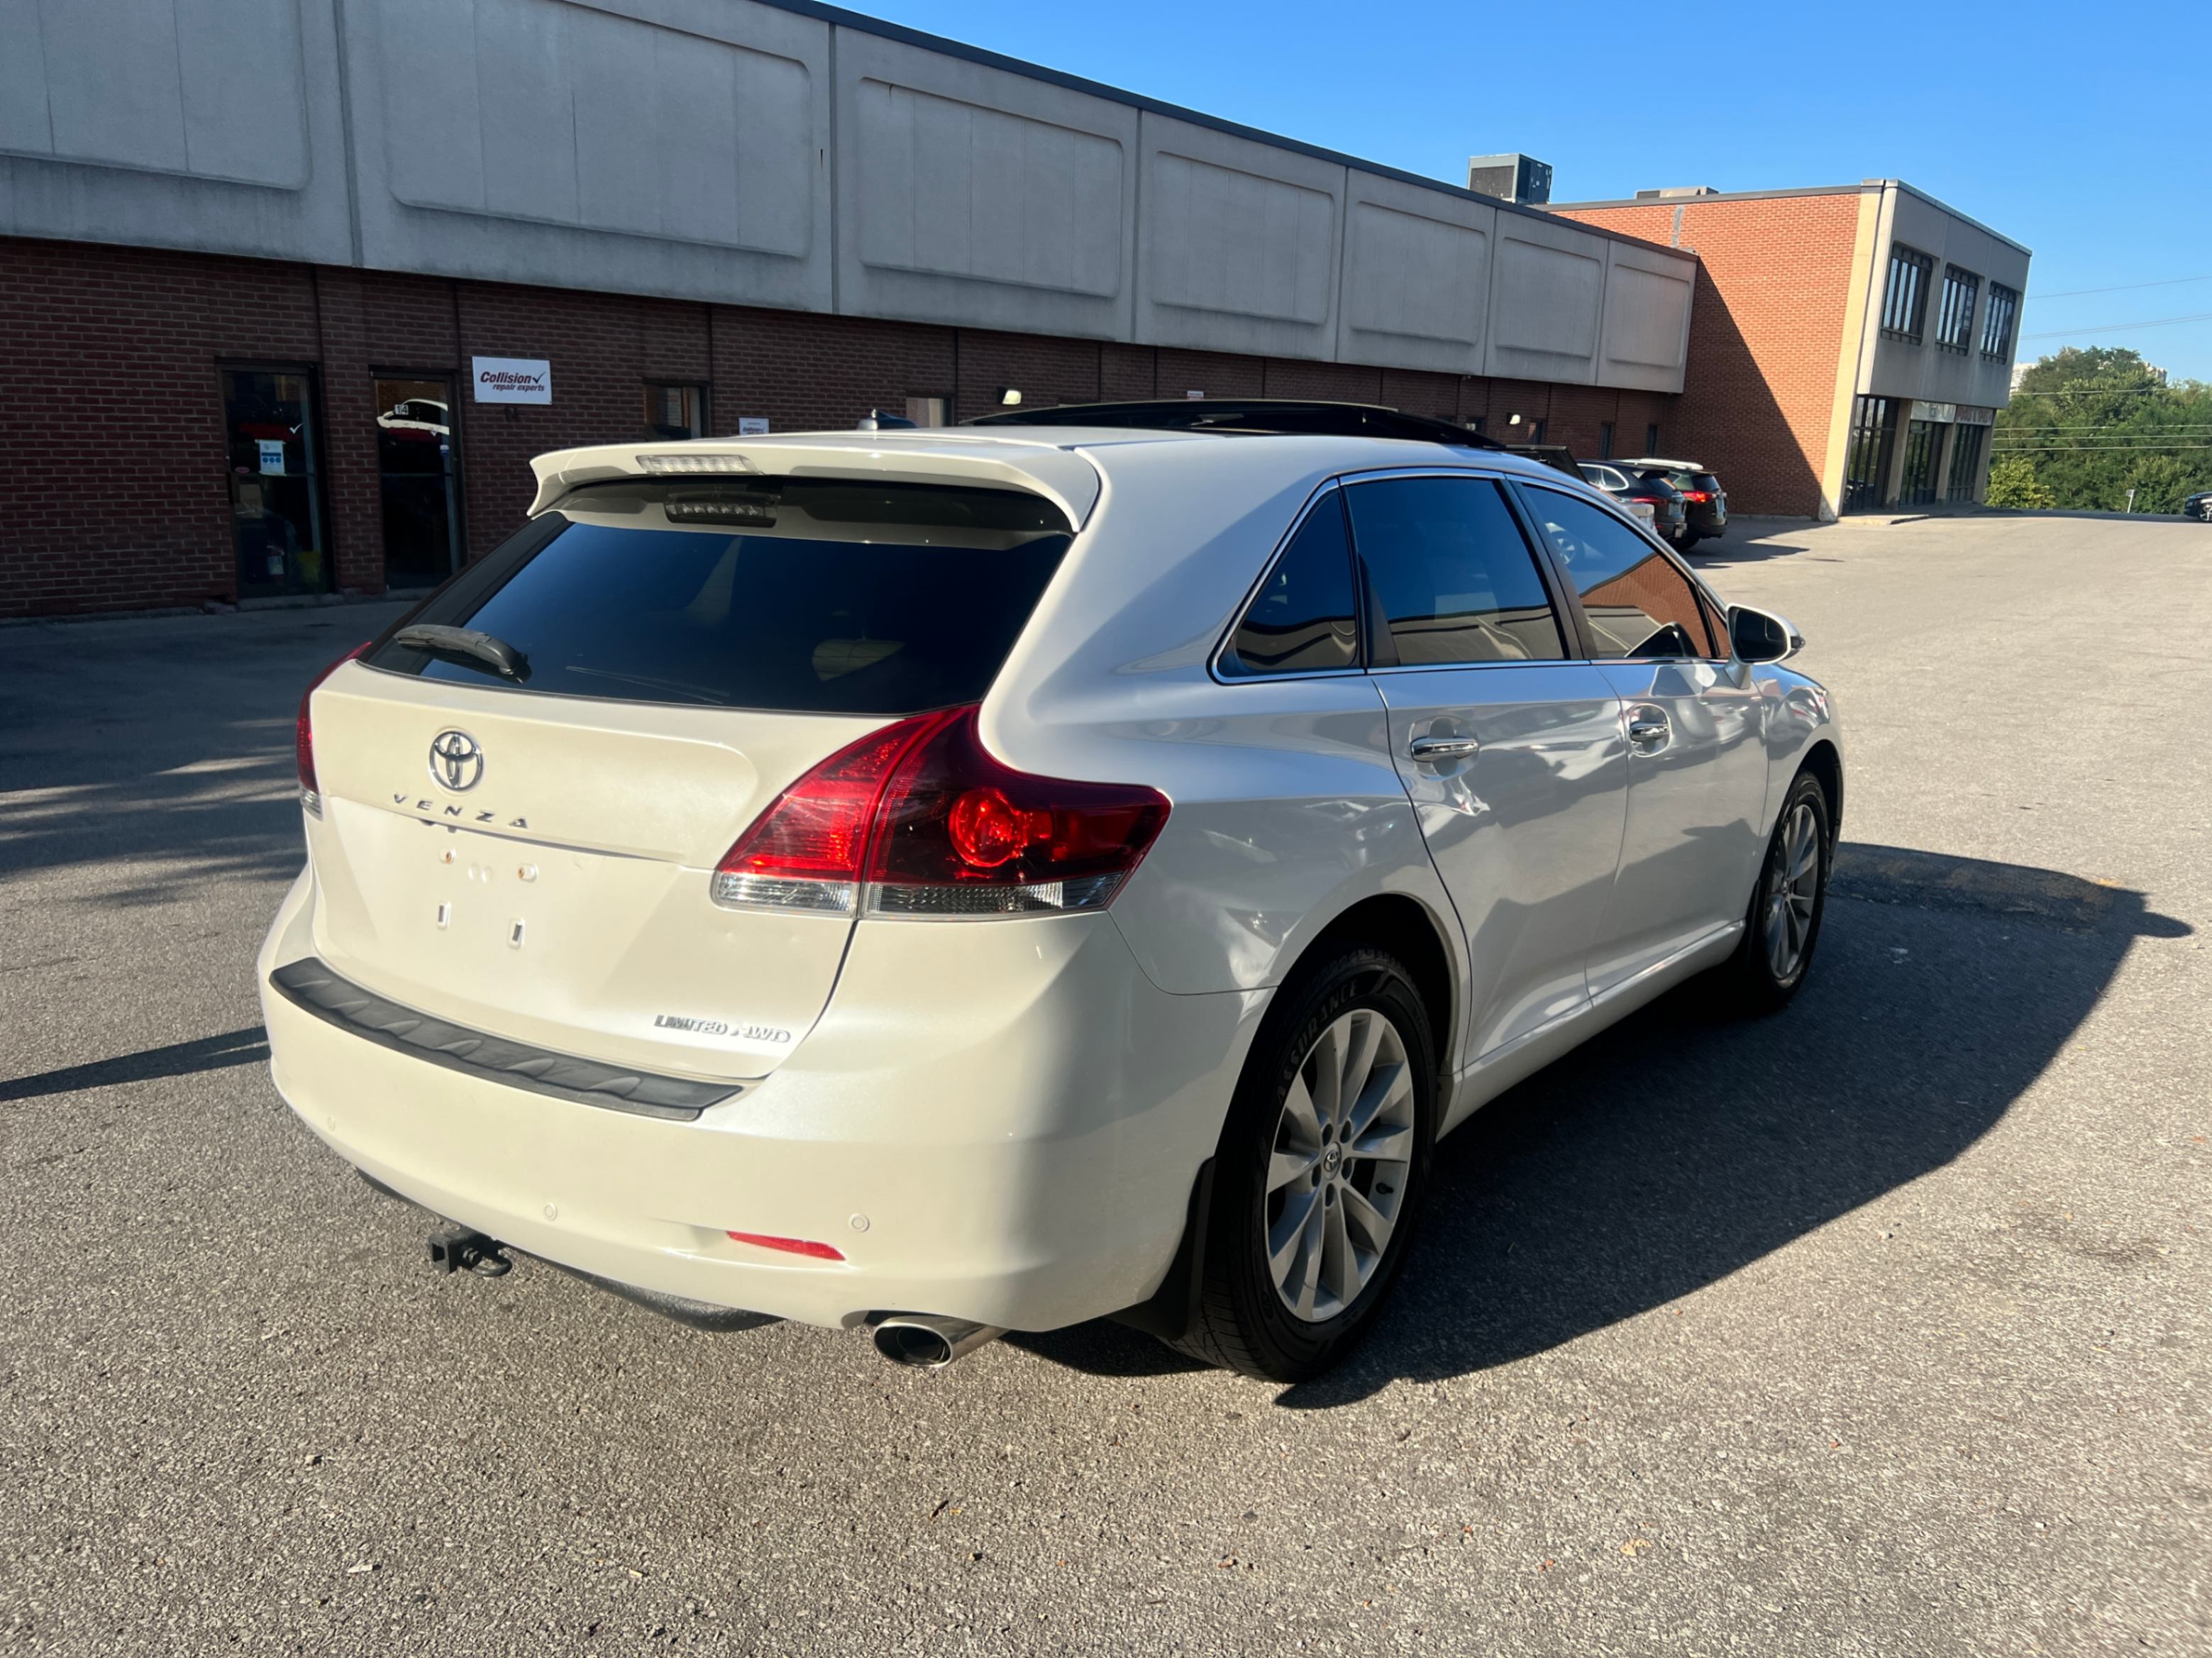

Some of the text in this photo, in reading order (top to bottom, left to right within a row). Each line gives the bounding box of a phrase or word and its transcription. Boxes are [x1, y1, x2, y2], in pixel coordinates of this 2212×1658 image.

[480, 372, 531, 384] Collision
[397, 404, 408, 414] 14
[394, 794, 529, 829] VENZA
[654, 1015, 791, 1044] LIMITED AWD
